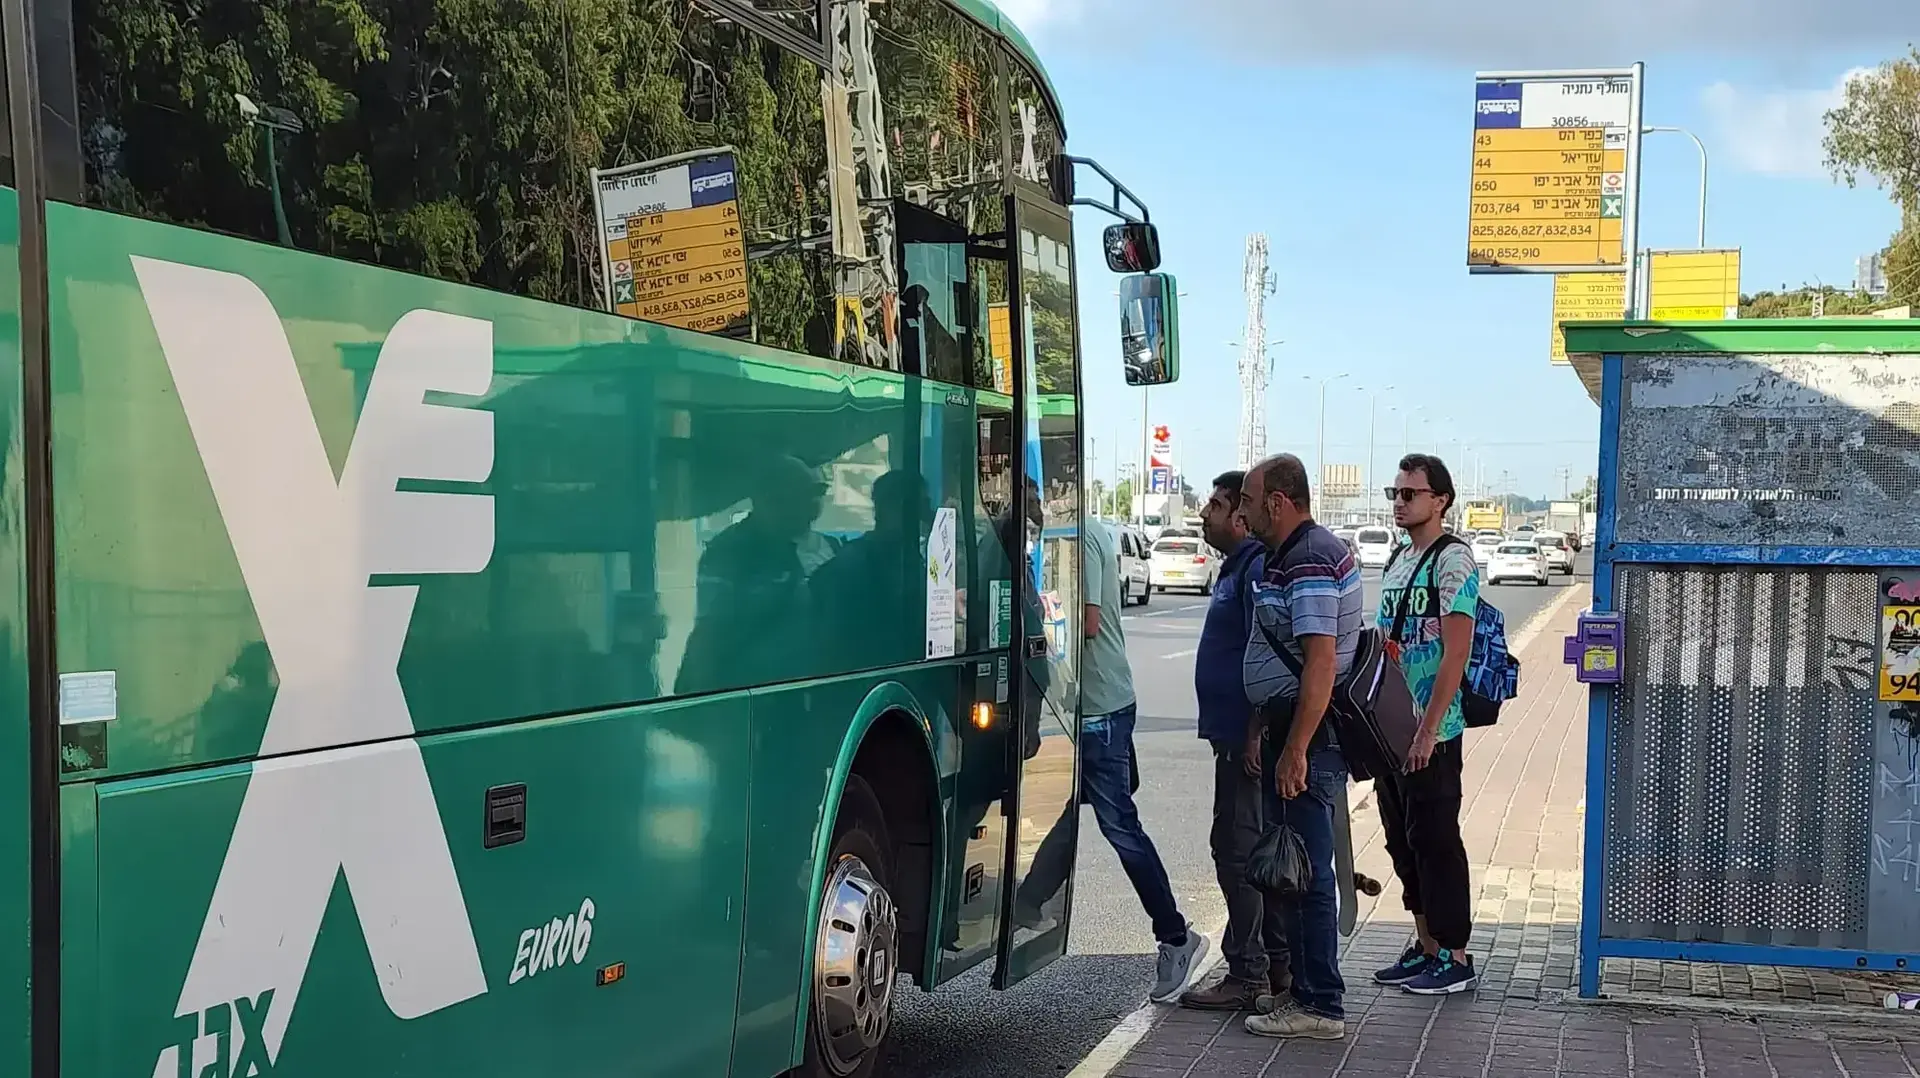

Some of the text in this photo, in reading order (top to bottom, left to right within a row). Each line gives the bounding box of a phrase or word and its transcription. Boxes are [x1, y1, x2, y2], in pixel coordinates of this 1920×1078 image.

[1562, 82, 1628, 95] מחלף נתניה
[1551, 116, 1589, 127] 30856
[1477, 135, 1491, 146] 43
[1559, 130, 1575, 141] הס
[1579, 130, 1603, 141] כפר
[1475, 158, 1491, 169] 44
[1561, 151, 1602, 164] עזריאל
[1474, 180, 1497, 191] 650
[1534, 174, 1601, 188] תל אביב יפו
[1473, 203, 1520, 215] 703,784
[1532, 197, 1599, 210] תל אביב יפו
[1471, 247, 1541, 260] 840,852,910
[1382, 587, 1430, 617] SYHO
